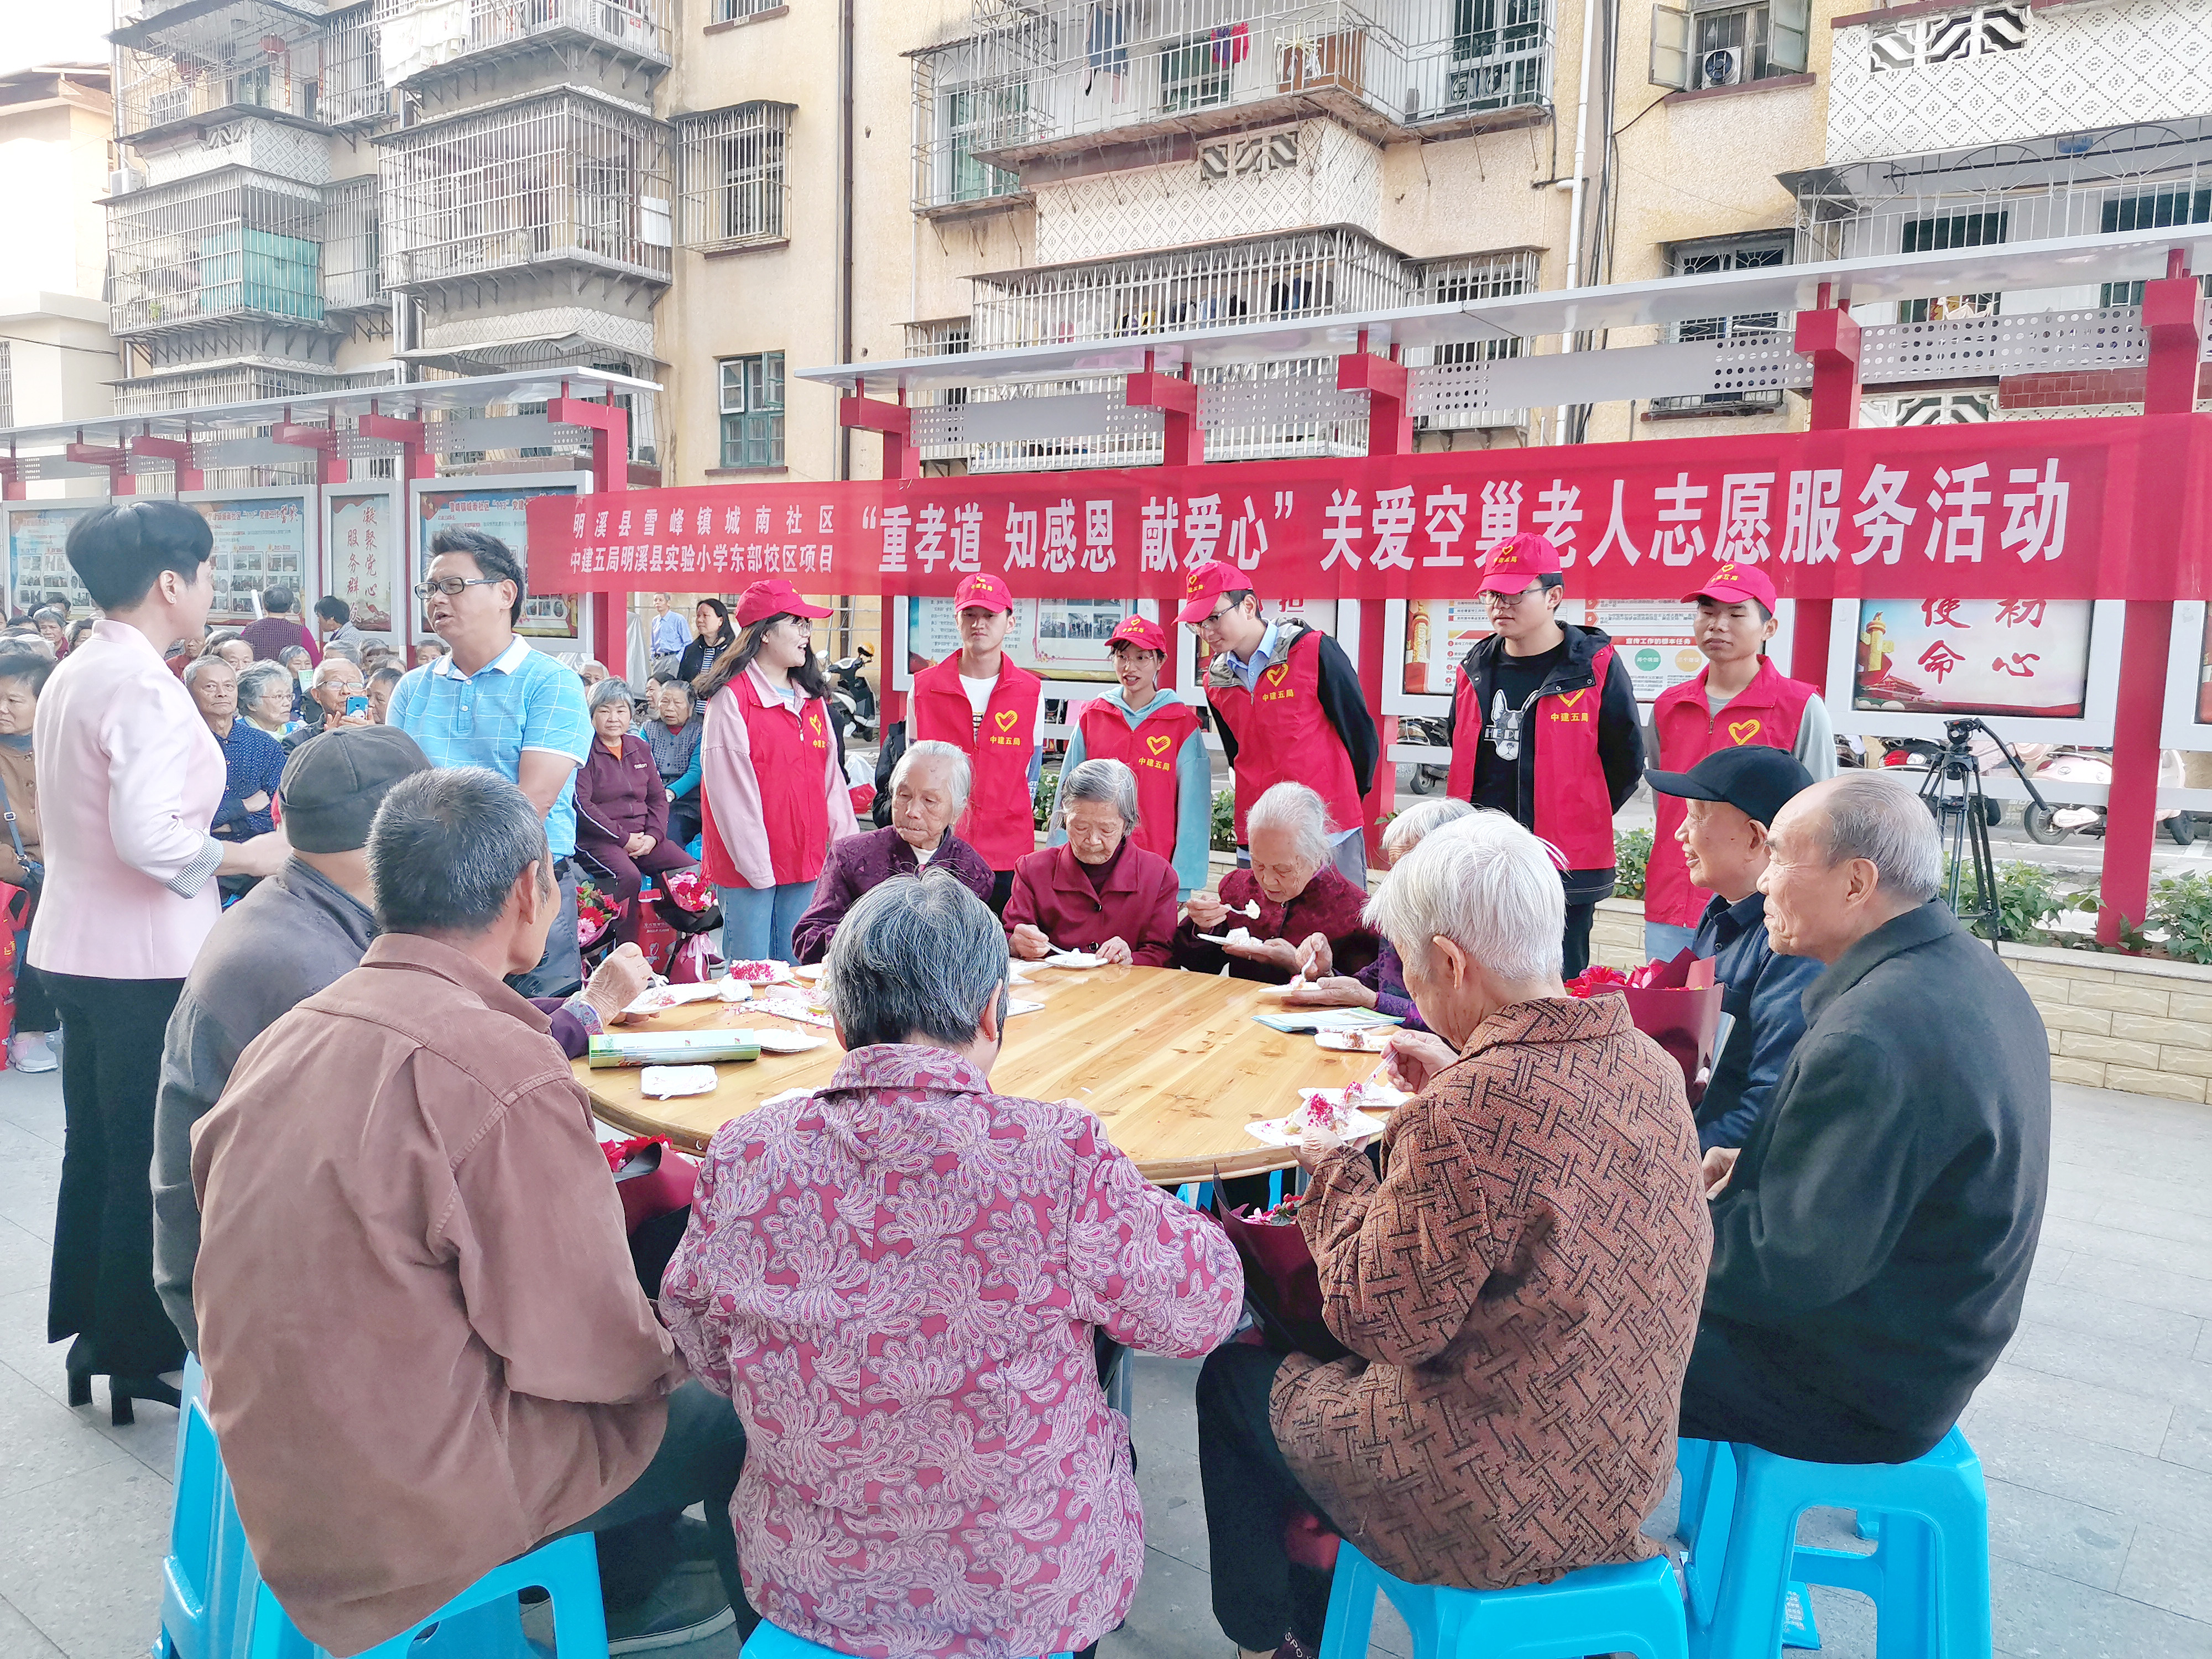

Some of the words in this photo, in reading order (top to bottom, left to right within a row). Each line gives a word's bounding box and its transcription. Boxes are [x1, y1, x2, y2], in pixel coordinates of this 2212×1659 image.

[572, 504, 834, 539] 明溪县雪峰镇城南社区
[1003, 498, 1117, 573] 知感恩
[1319, 457, 2070, 572] 关爱空巢老人志愿服务活动
[363, 507, 378, 597] 凝聚党心
[570, 543, 833, 574] 中建五局明溪县实验小学东部校区项目
[1262, 689, 1295, 702] 中建五局
[1550, 712, 1589, 722] 中建五局
[989, 735, 1021, 745] 中建五局
[1138, 757, 1170, 771] 中建五局
